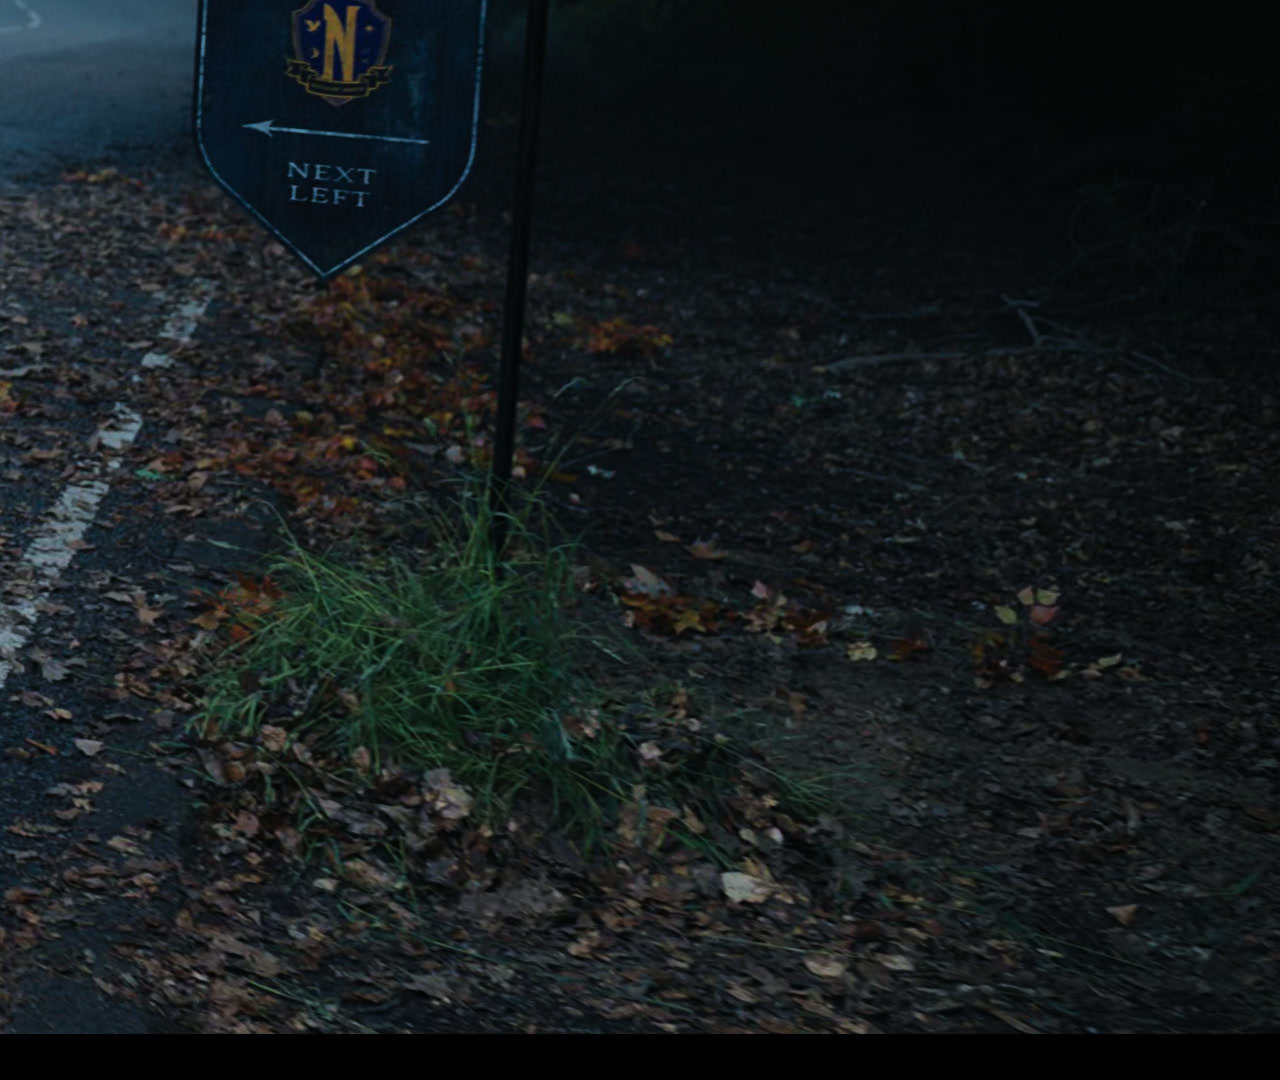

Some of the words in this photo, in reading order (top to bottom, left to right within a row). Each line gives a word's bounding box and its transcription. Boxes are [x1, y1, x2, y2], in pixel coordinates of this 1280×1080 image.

[323, 3, 361, 82] N
[287, 161, 377, 186] NEXT
[288, 185, 372, 208] LEFT
